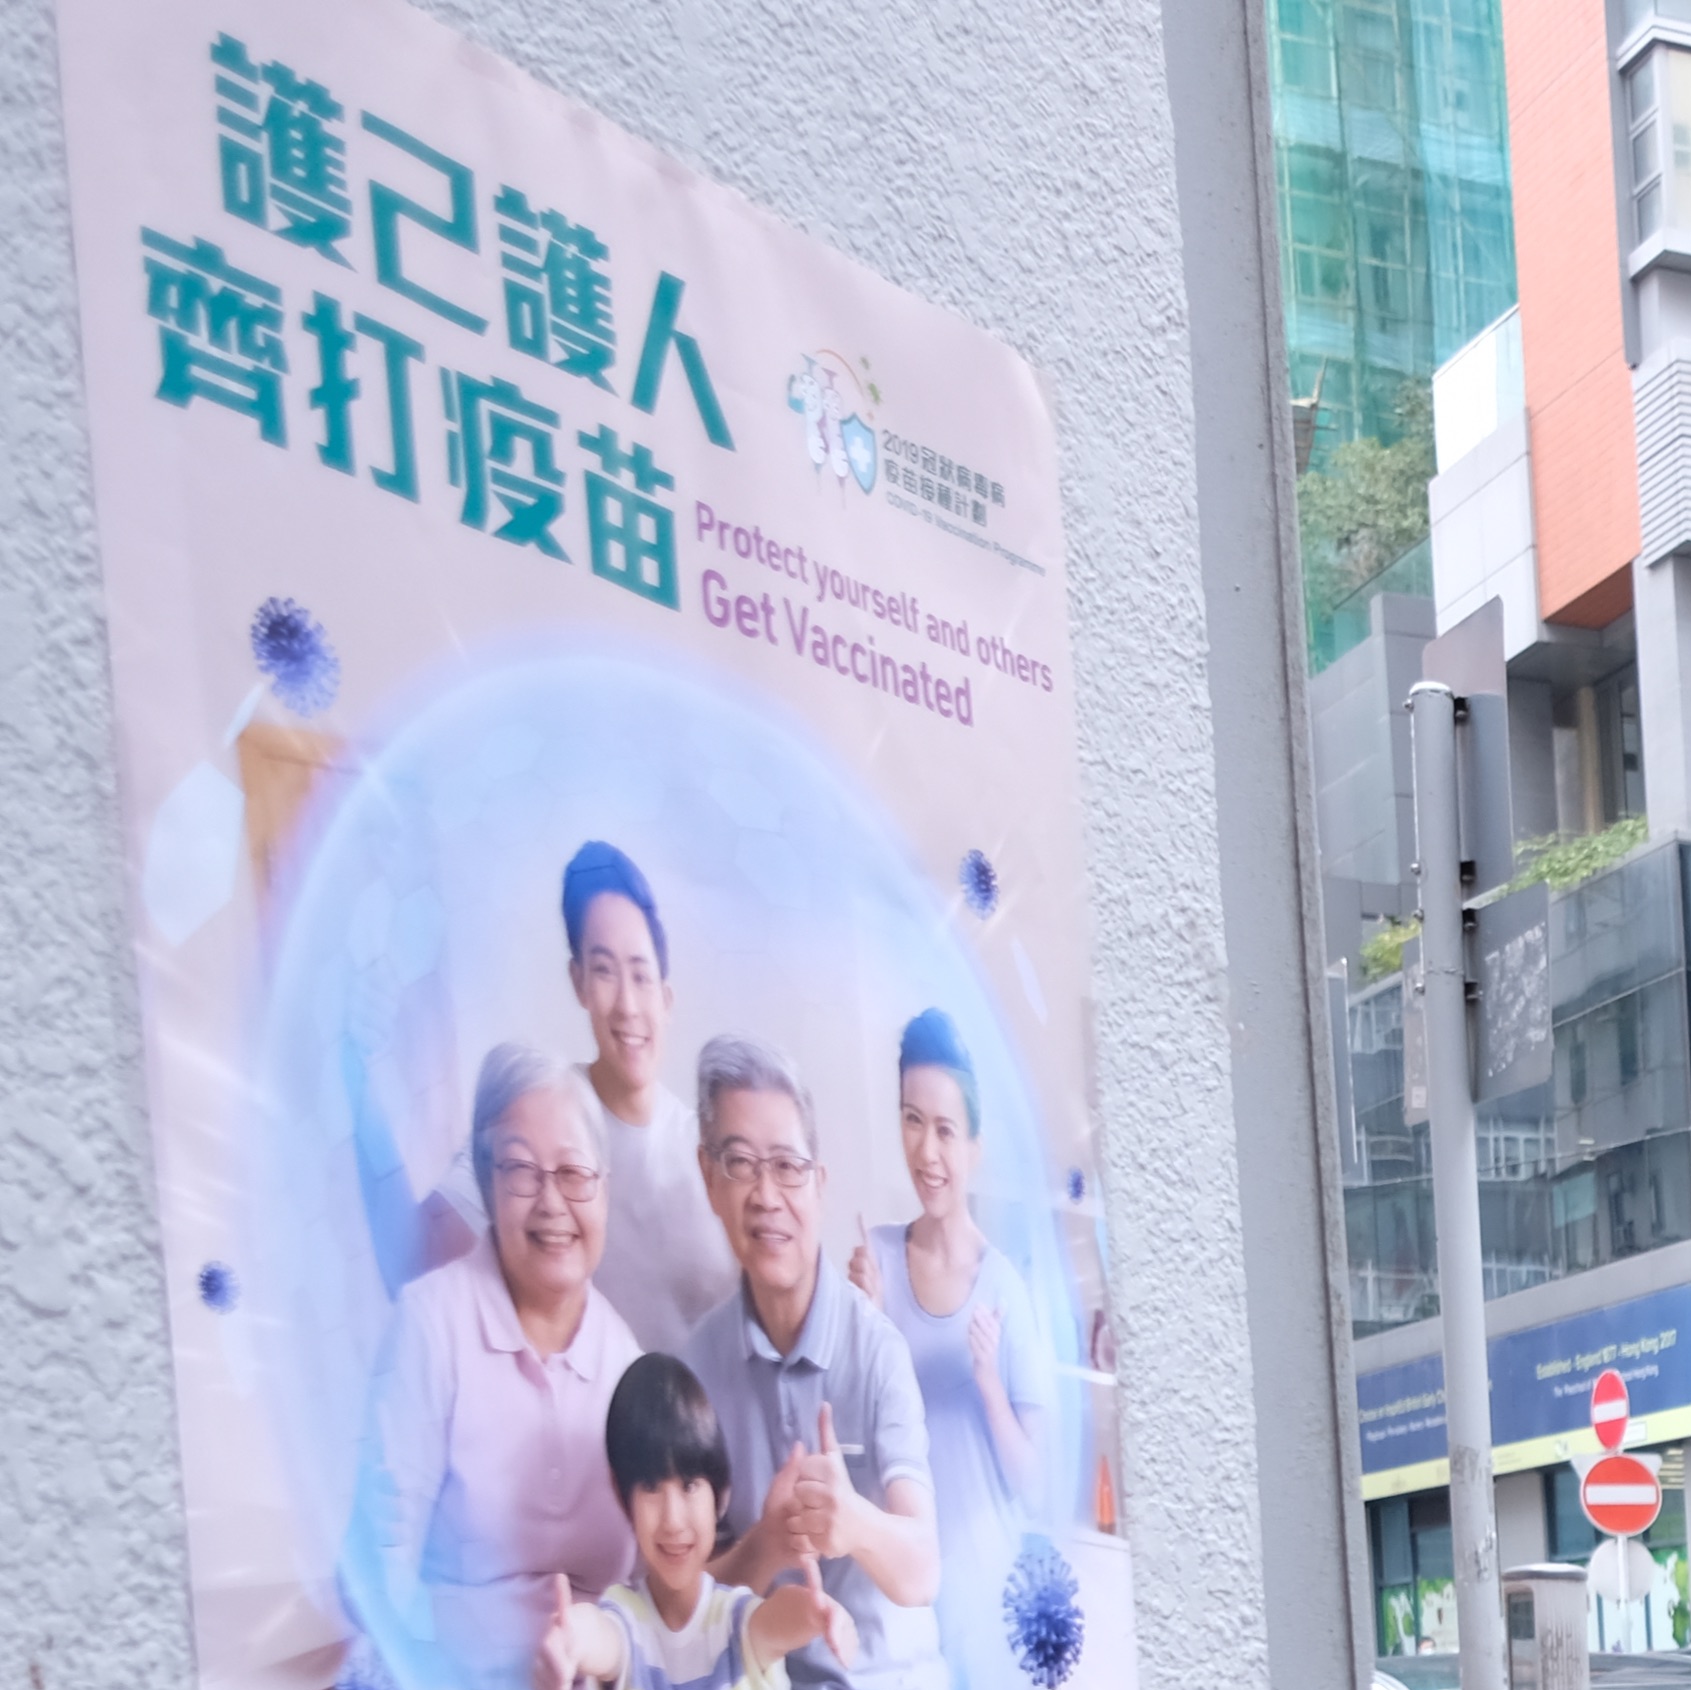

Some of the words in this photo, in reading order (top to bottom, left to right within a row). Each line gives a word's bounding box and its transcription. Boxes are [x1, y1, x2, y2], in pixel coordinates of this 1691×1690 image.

[209, 30, 737, 453] 護己護人
[140, 224, 682, 613] 齊打疫苗
[695, 499, 810, 586] Protect
[813, 559, 921, 634] yourself
[925, 612, 971, 657] and
[975, 634, 1054, 694] others
[701, 568, 779, 647] Get
[782, 596, 975, 728] Vaccinated
